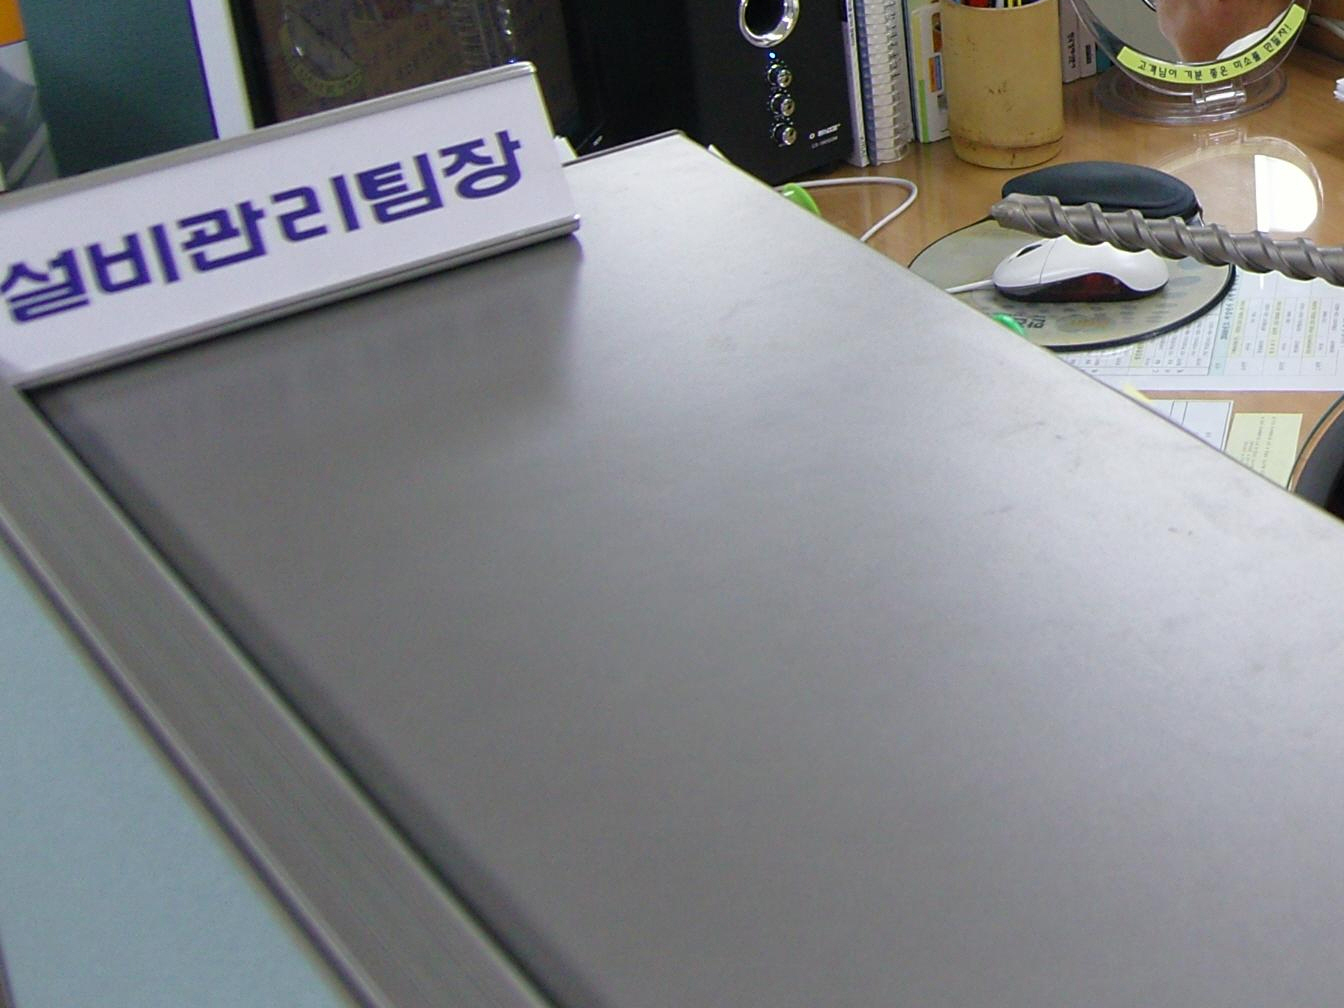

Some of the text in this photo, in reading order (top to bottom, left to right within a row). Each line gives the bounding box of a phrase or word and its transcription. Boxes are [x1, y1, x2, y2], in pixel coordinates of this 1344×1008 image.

[1184, 68, 1203, 81] 기분
[1209, 65, 1229, 79] 좋은
[1233, 50, 1262, 70] 미소를
[0, 129, 523, 324] 설비관리팀장
